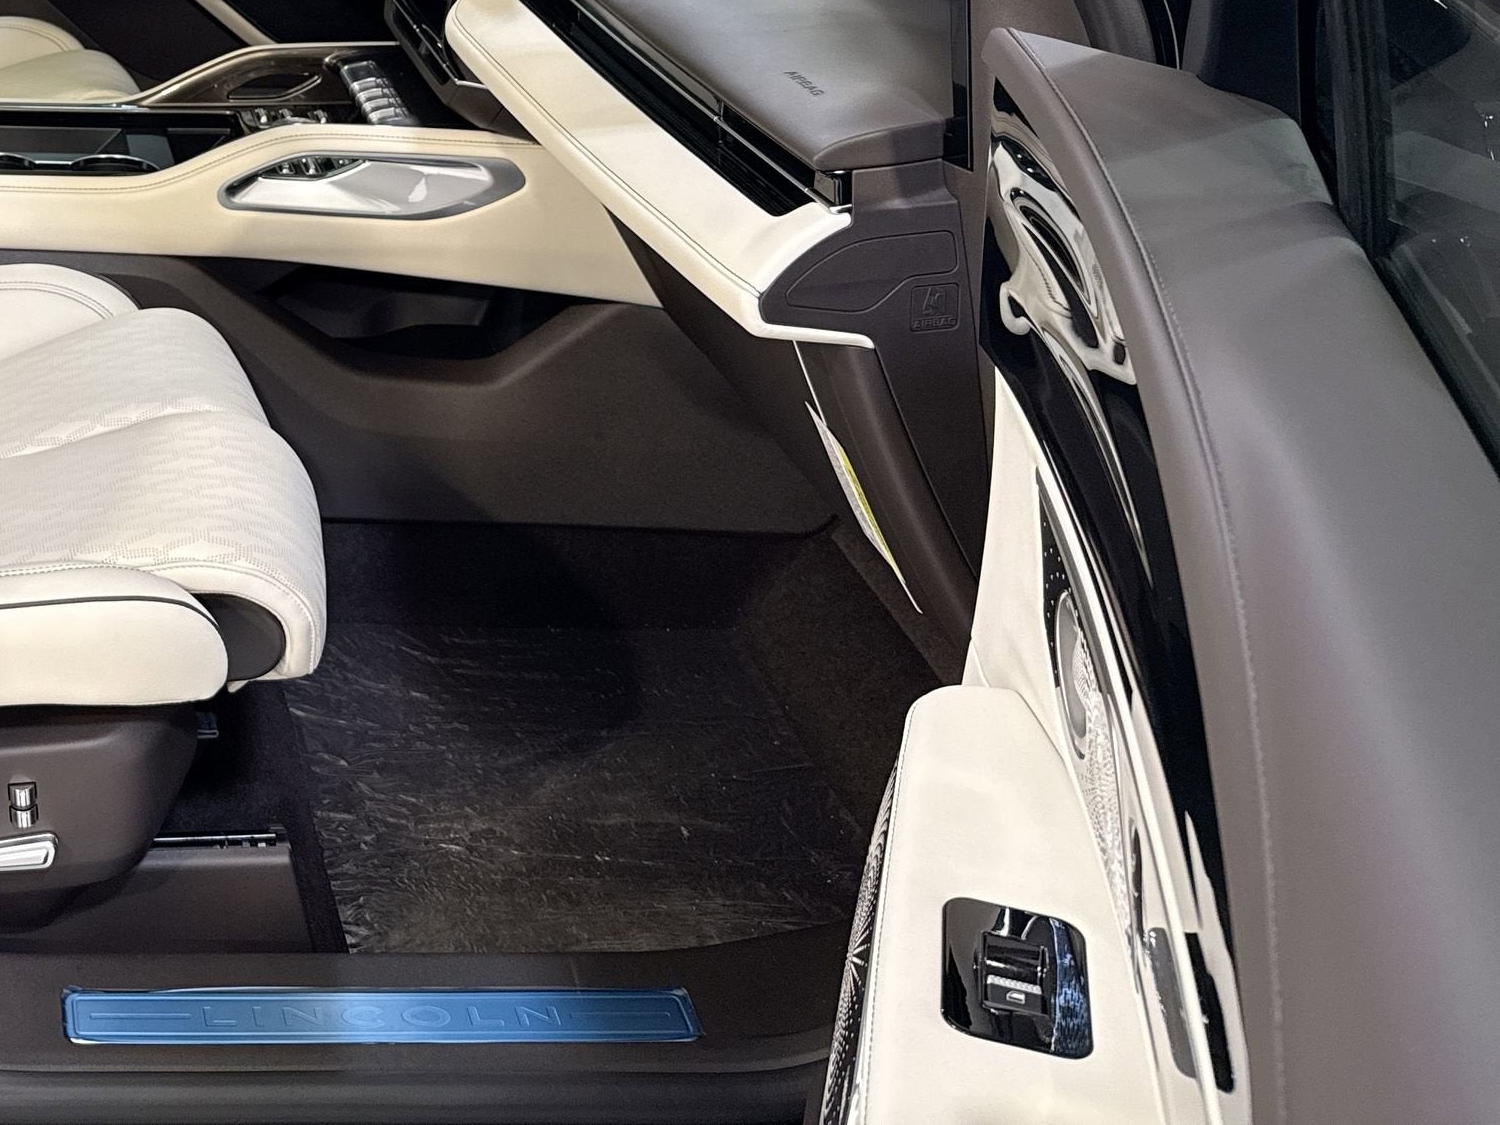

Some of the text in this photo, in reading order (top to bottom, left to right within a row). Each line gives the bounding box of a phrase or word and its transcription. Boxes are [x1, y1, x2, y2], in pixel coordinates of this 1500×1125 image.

[783, 71, 825, 96] AIRBAG
[913, 317, 956, 329] AIRBAG
[204, 1004, 563, 1029] LINCOLN
